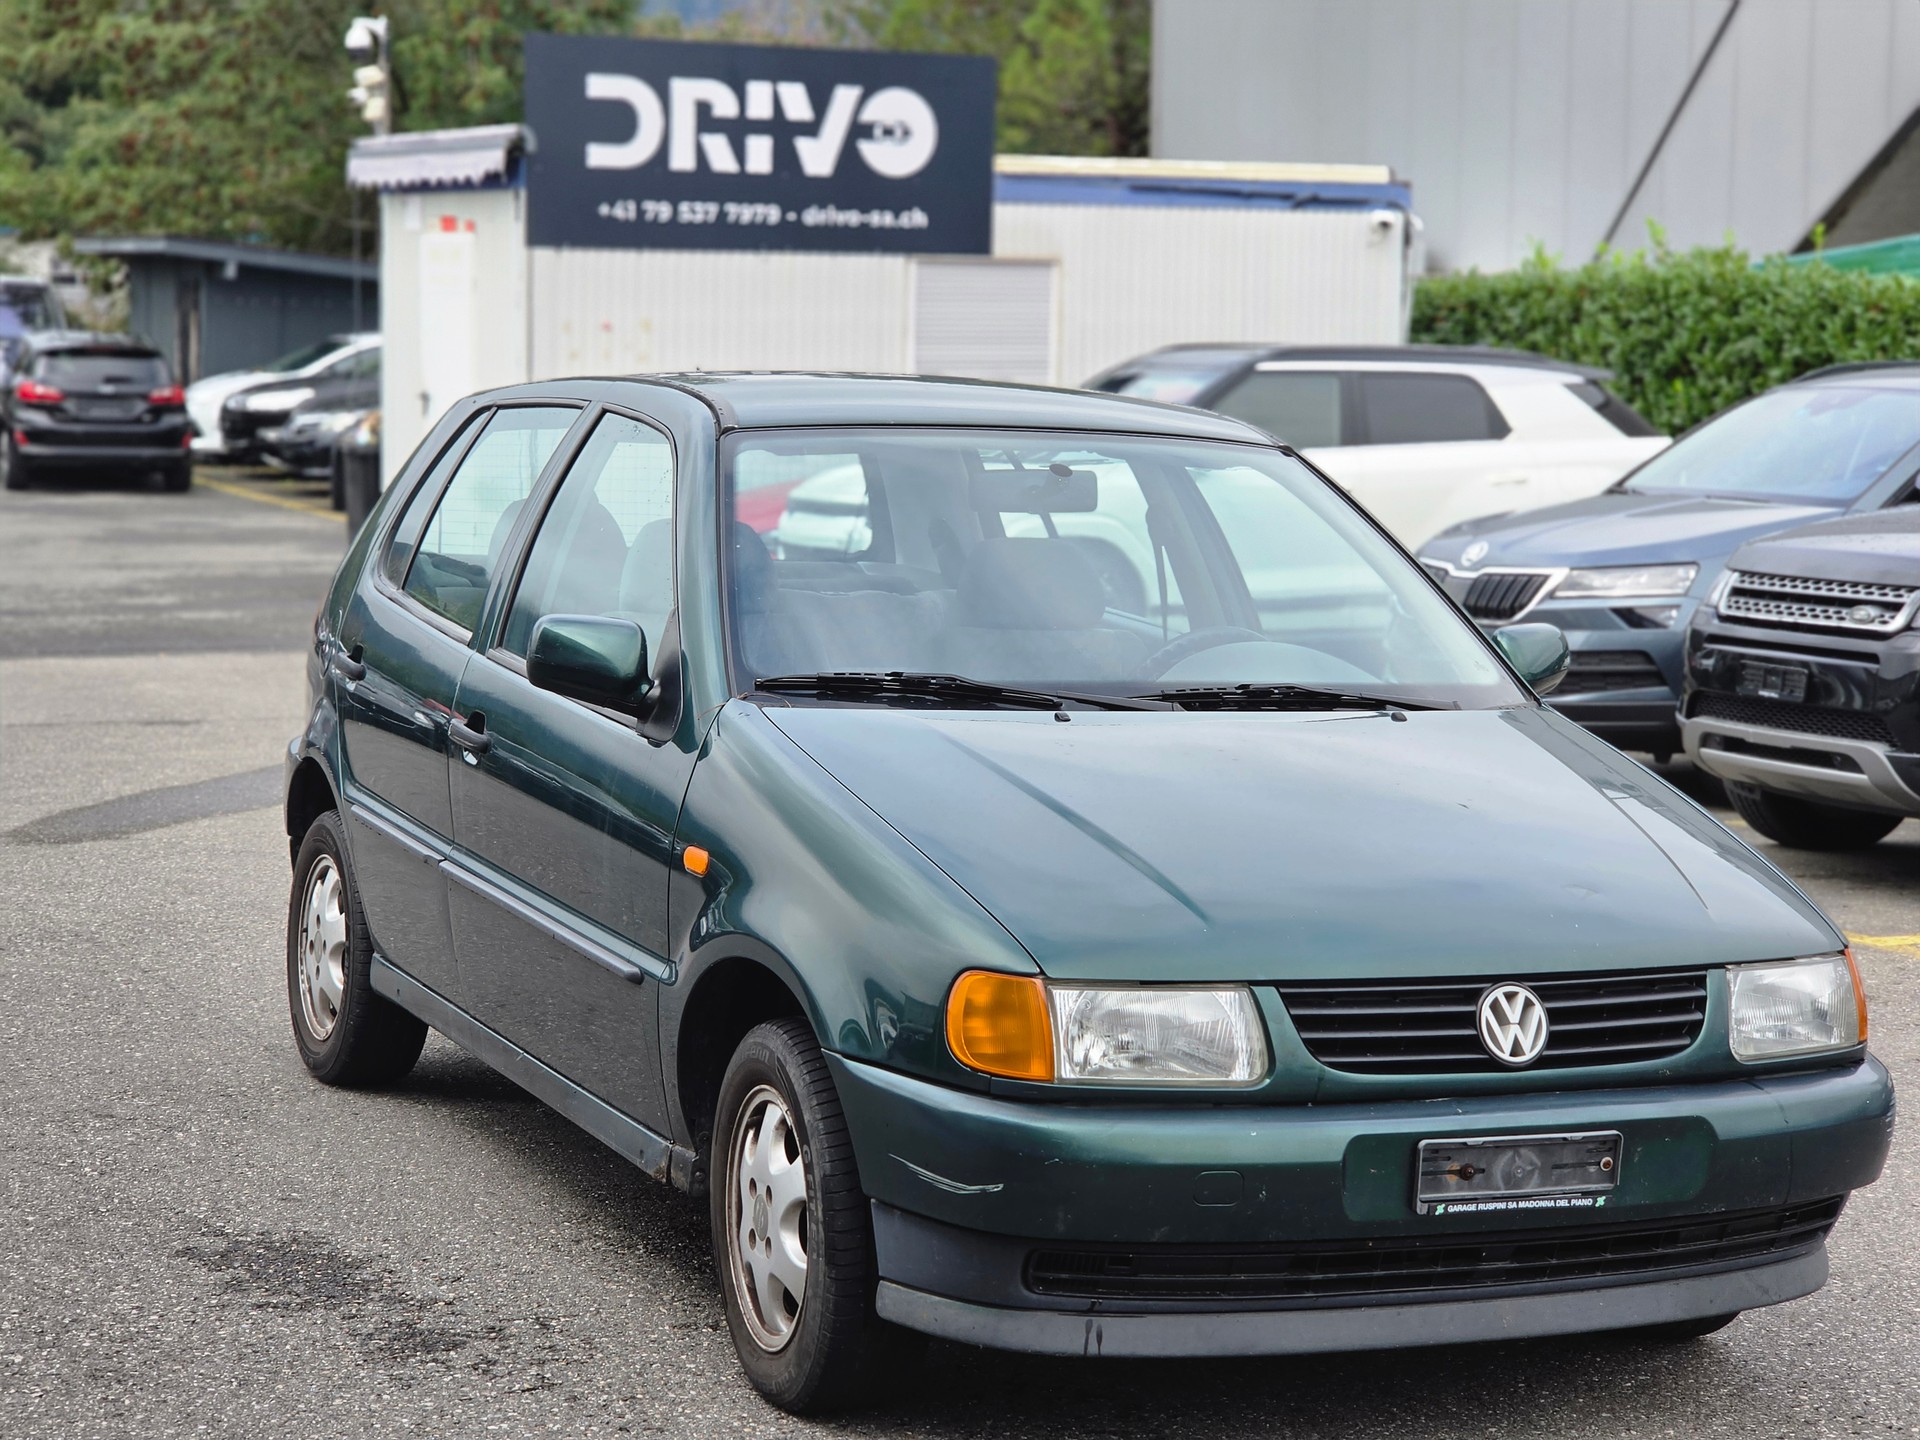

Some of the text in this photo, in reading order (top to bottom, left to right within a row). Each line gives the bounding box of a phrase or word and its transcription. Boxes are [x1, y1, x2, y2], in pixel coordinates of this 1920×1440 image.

[585, 72, 939, 179] DRIVO
[598, 200, 637, 222] +41
[640, 200, 673, 224] 79
[676, 201, 720, 225] 537
[801, 204, 929, 229] drivo-sa.ch
[1481, 985, 1547, 1063] VW
[1447, 1198, 1593, 1213] GARAGE RUSPINI SA MADONNA DEL PIANO
